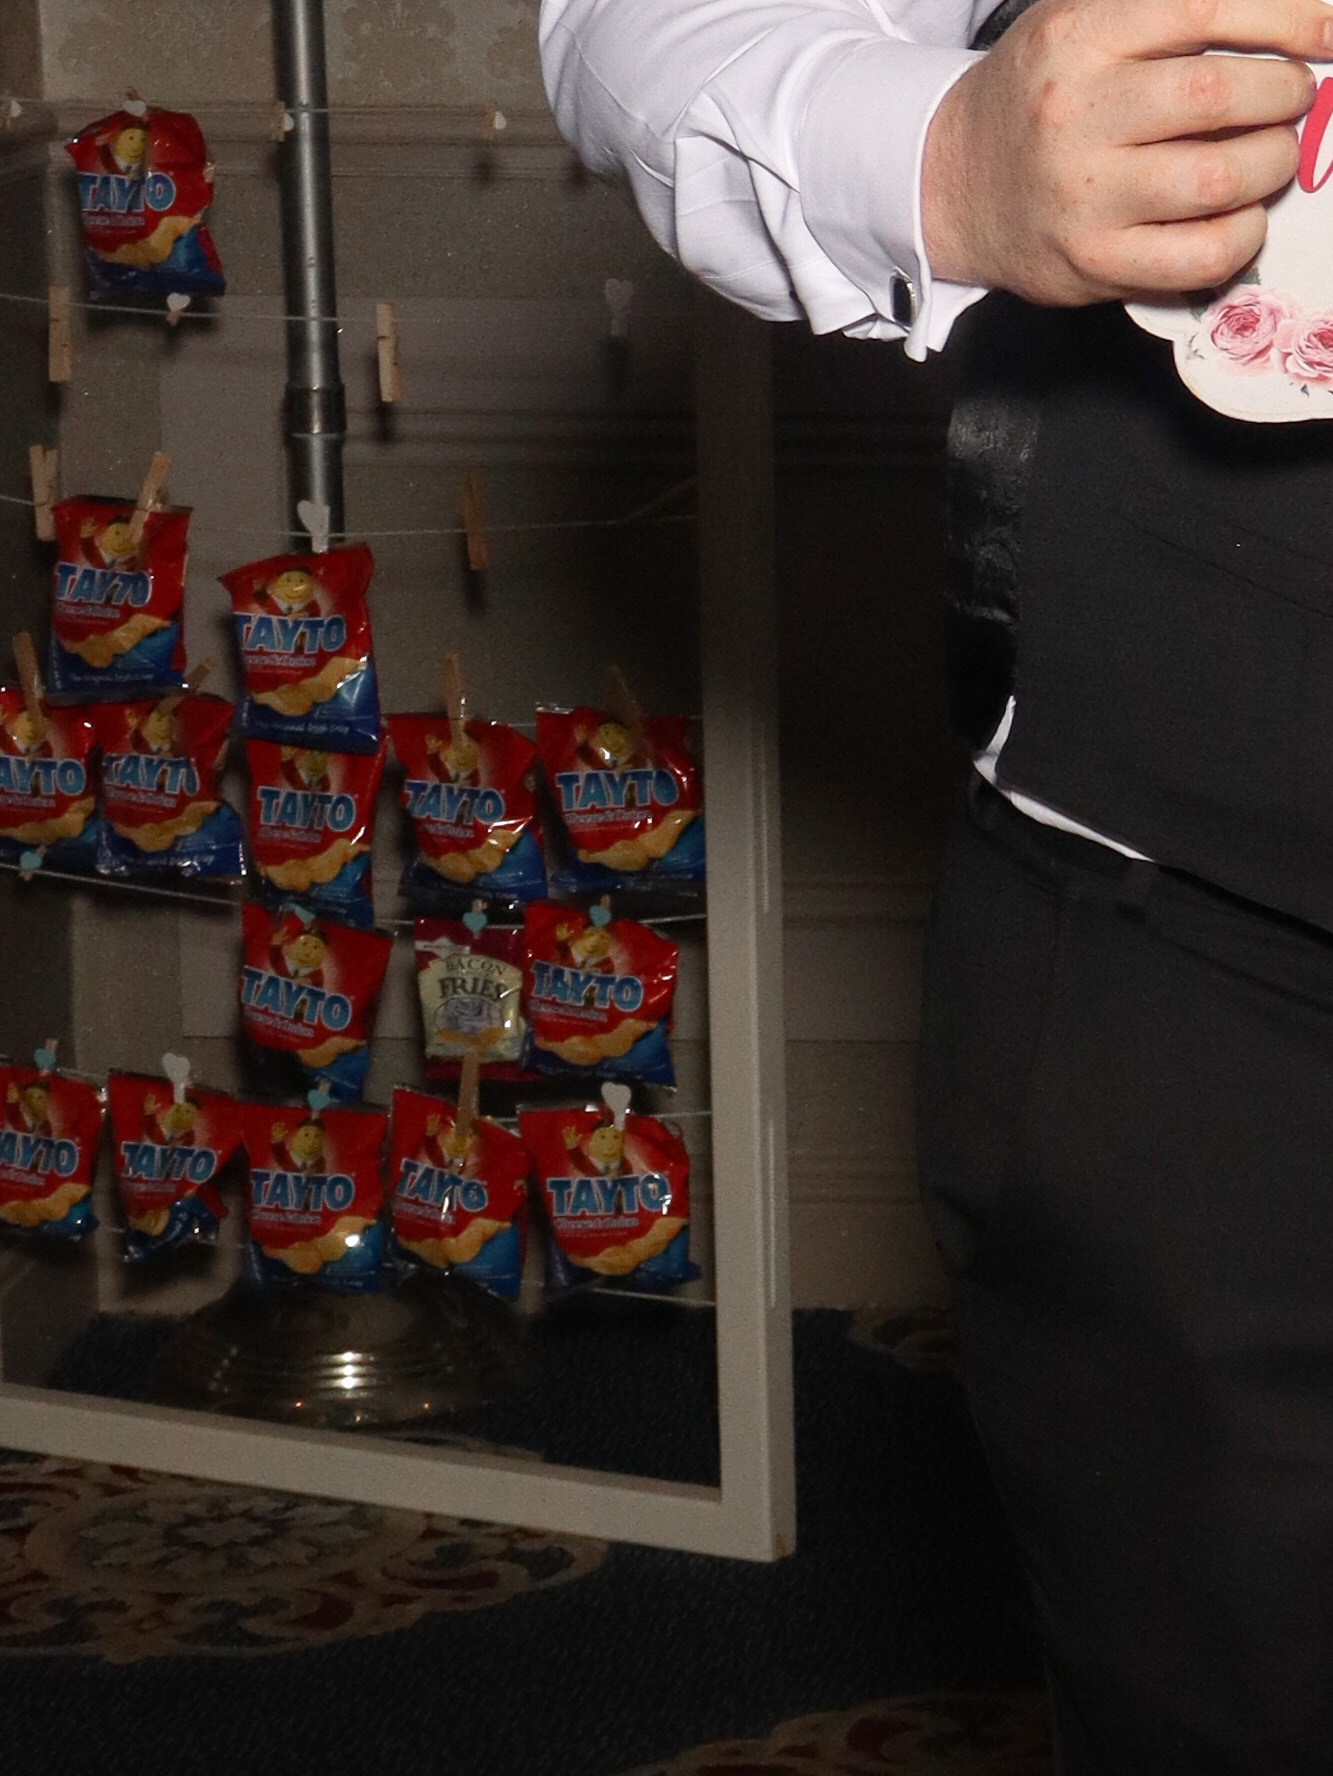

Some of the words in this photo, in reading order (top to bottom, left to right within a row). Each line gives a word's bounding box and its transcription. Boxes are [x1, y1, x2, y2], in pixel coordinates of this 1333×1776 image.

[233, 612, 347, 654] TAYTO
[257, 785, 356, 832] TAYTO
[404, 779, 505, 825] TAYTO
[555, 768, 680, 812] TAYTO
[241, 965, 352, 1031] TAYTO
[439, 977, 509, 1002] FRIES
[531, 959, 644, 1012] TAYTO
[0, 1129, 79, 1178] AYTO
[121, 1140, 218, 1183] TAYTO
[250, 1168, 356, 1212] TAYTO
[397, 1157, 489, 1212] TAYTO
[546, 1172, 671, 1216] TAYTO
